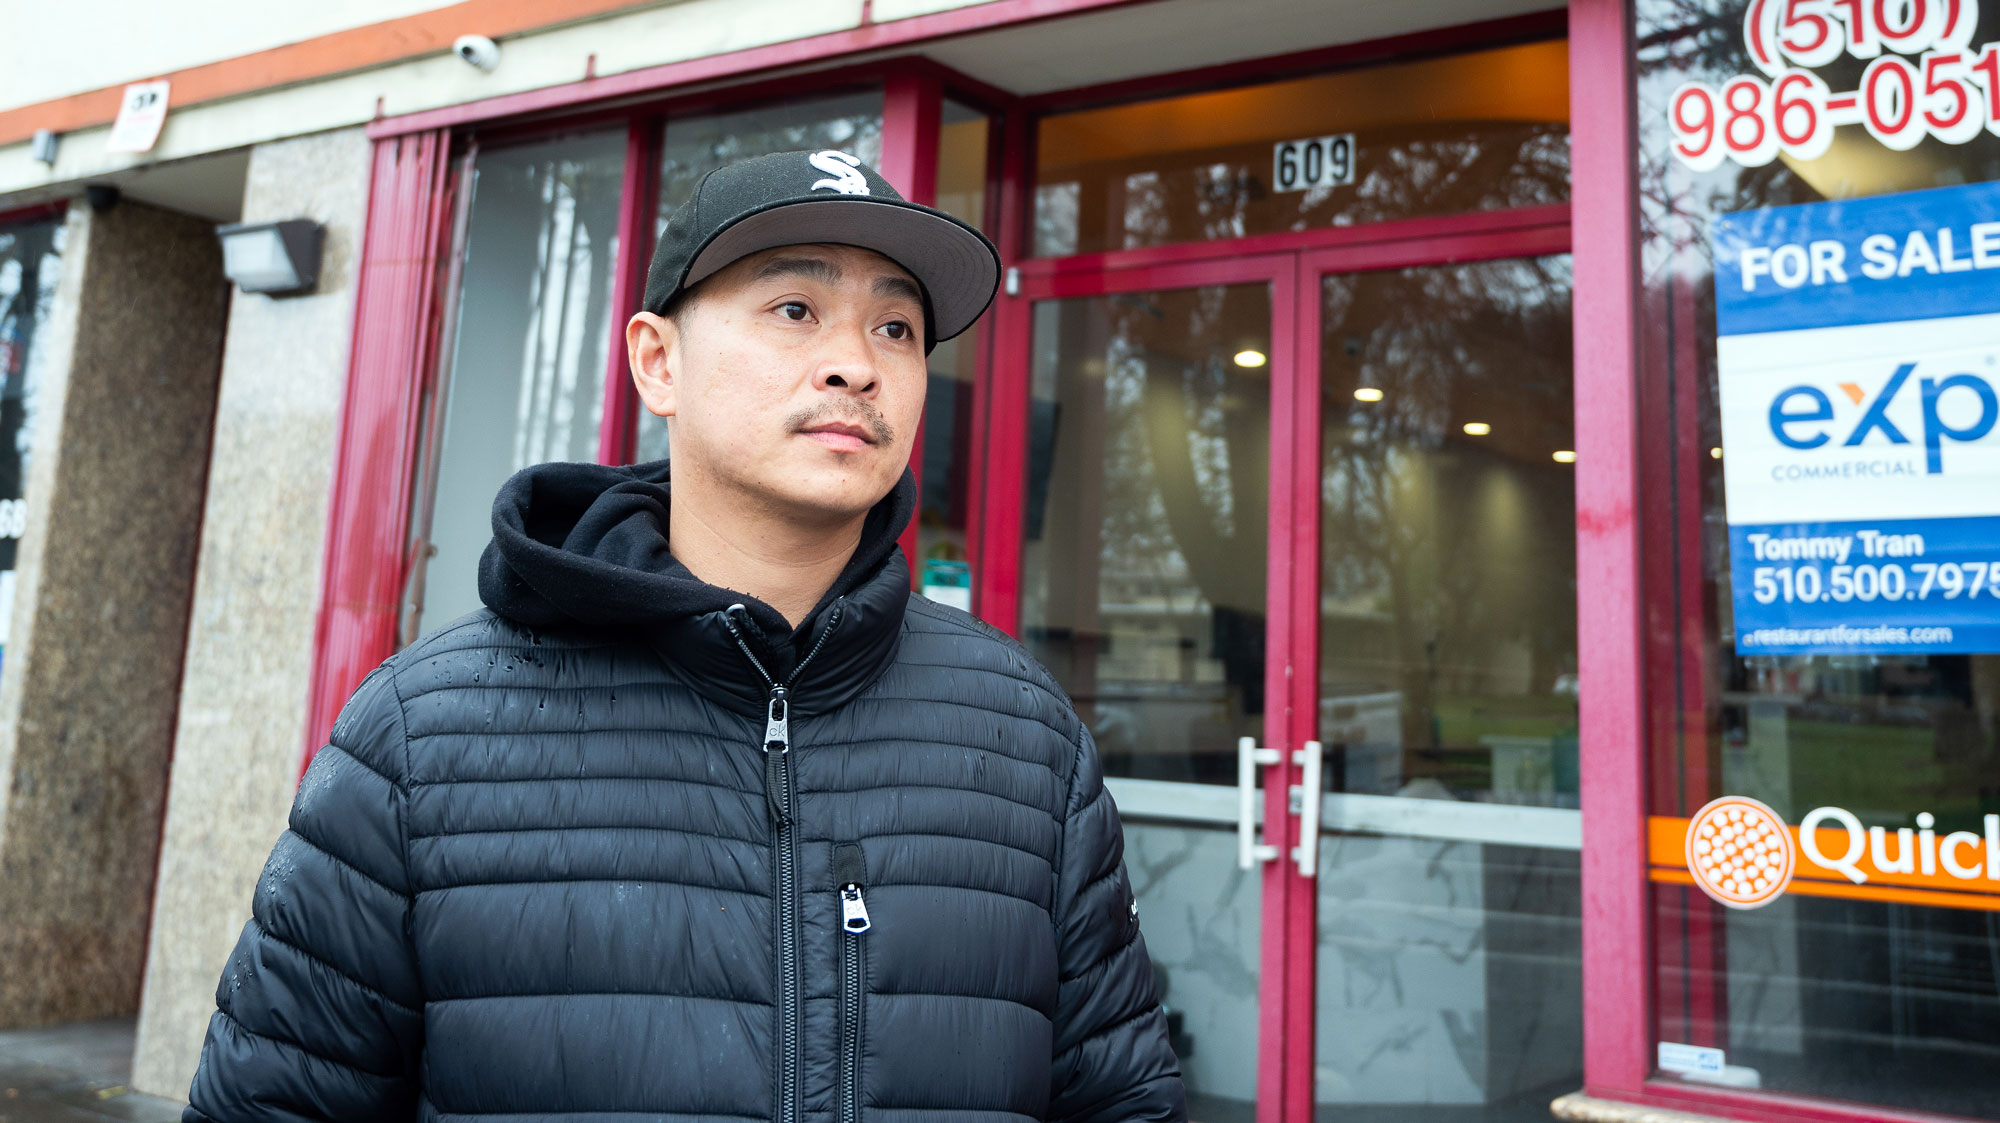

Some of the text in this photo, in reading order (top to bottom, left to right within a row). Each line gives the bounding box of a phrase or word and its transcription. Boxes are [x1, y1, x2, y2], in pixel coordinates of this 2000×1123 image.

[1748, 0, 1966, 66] (510)
[1280, 138, 1349, 187] 609
[1740, 222, 2000, 292] FOR SALE
[1771, 460, 1917, 482] COMMERCIAL
[1747, 530, 1925, 565] Tommy Tran
